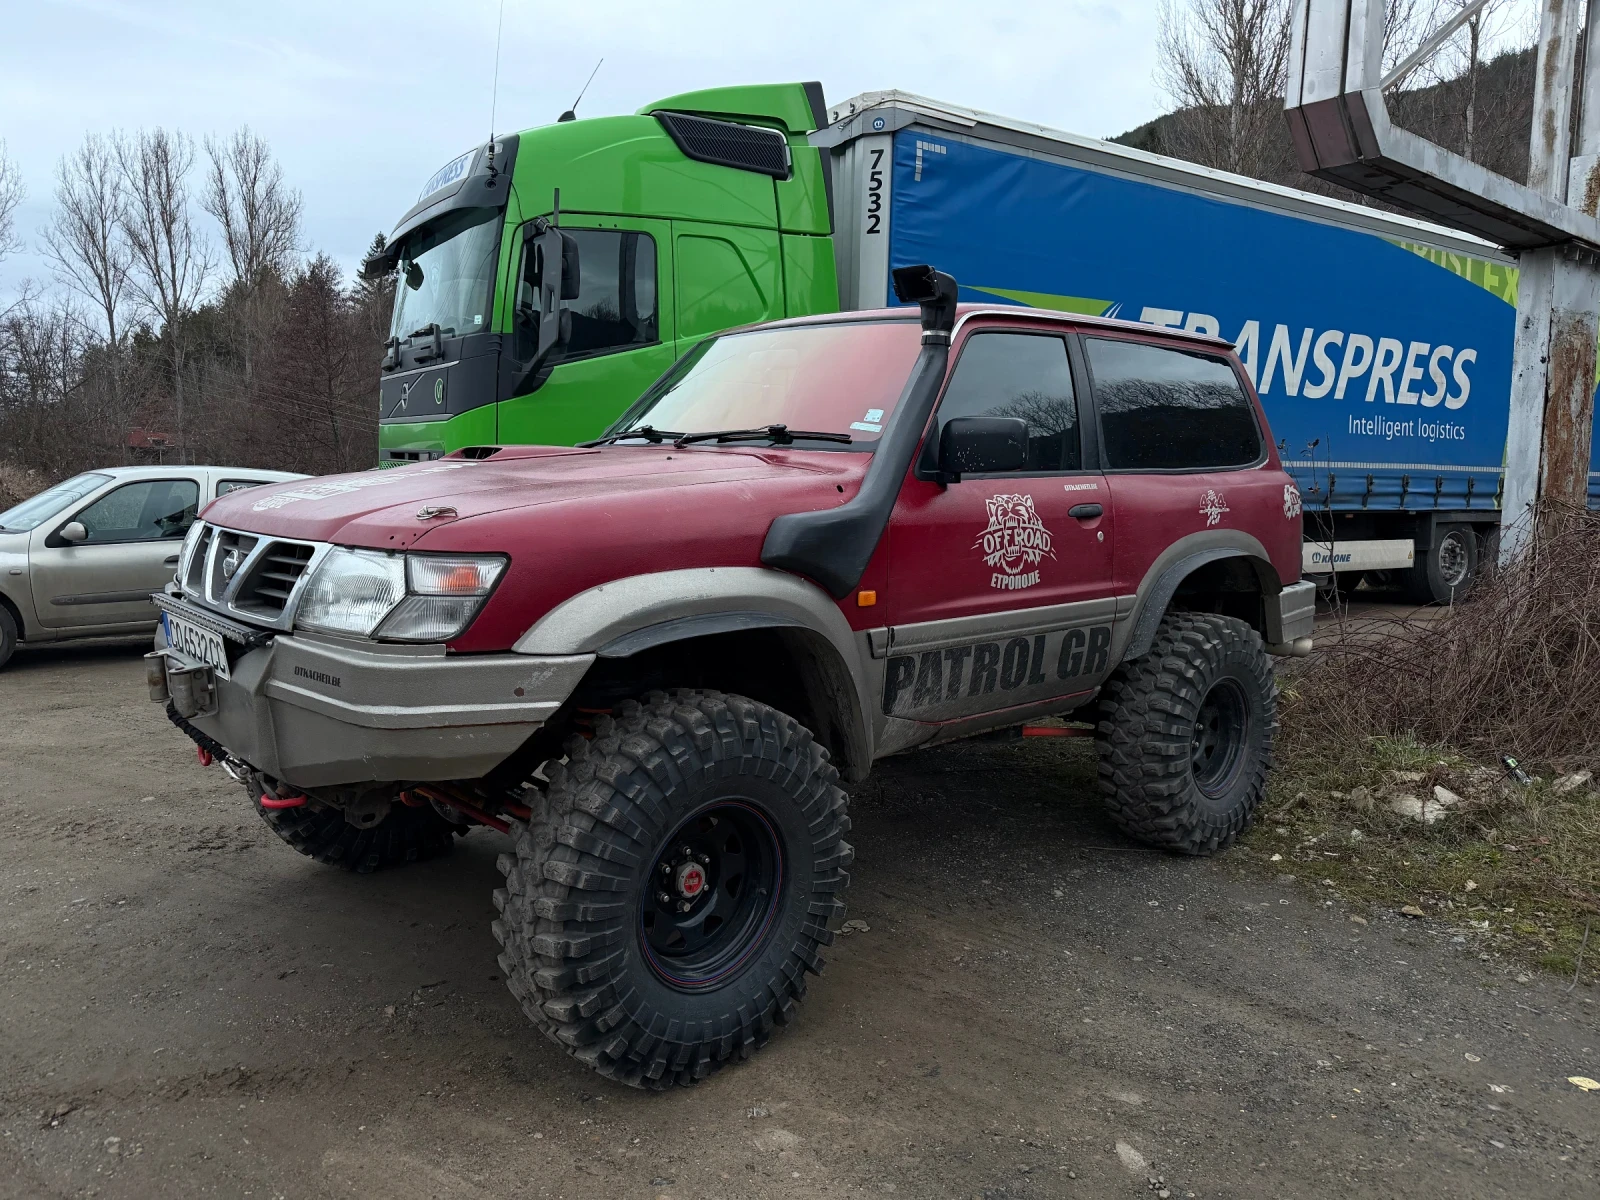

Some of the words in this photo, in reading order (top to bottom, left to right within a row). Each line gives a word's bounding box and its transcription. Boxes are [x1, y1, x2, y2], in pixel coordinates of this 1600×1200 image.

[866, 149, 885, 234] 7532
[1140, 306, 1477, 410] ANSPRESS
[1348, 414, 1414, 441] Intelligent
[1418, 417, 1465, 443] logistics
[990, 569, 1041, 590] ЕТРОПОЛЕ
[882, 635, 1046, 716] PATROL
[1056, 626, 1111, 680] GR
